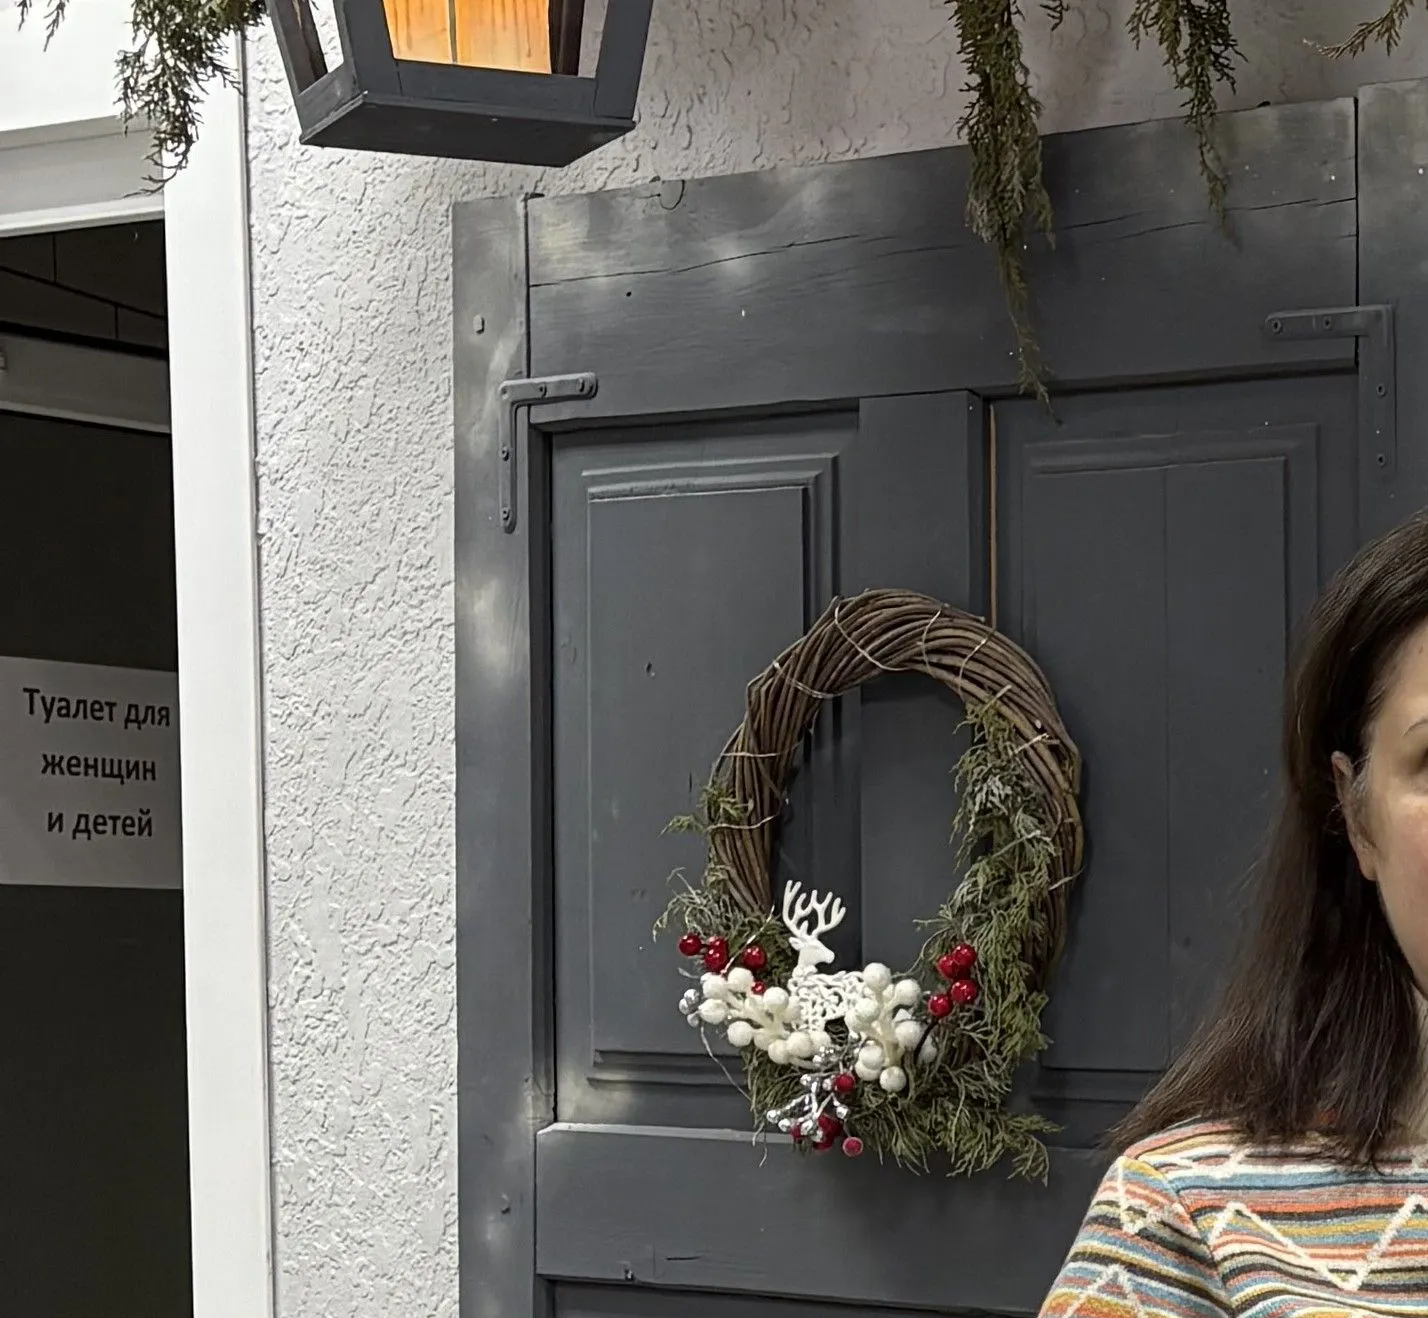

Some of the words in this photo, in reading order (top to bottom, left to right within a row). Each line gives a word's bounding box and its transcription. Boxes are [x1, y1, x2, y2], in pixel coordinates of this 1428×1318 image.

[22, 687, 117, 723] Туалет
[123, 702, 170, 730] для
[41, 753, 156, 785] женщин
[47, 811, 64, 833] и
[72, 808, 153, 840] детей
